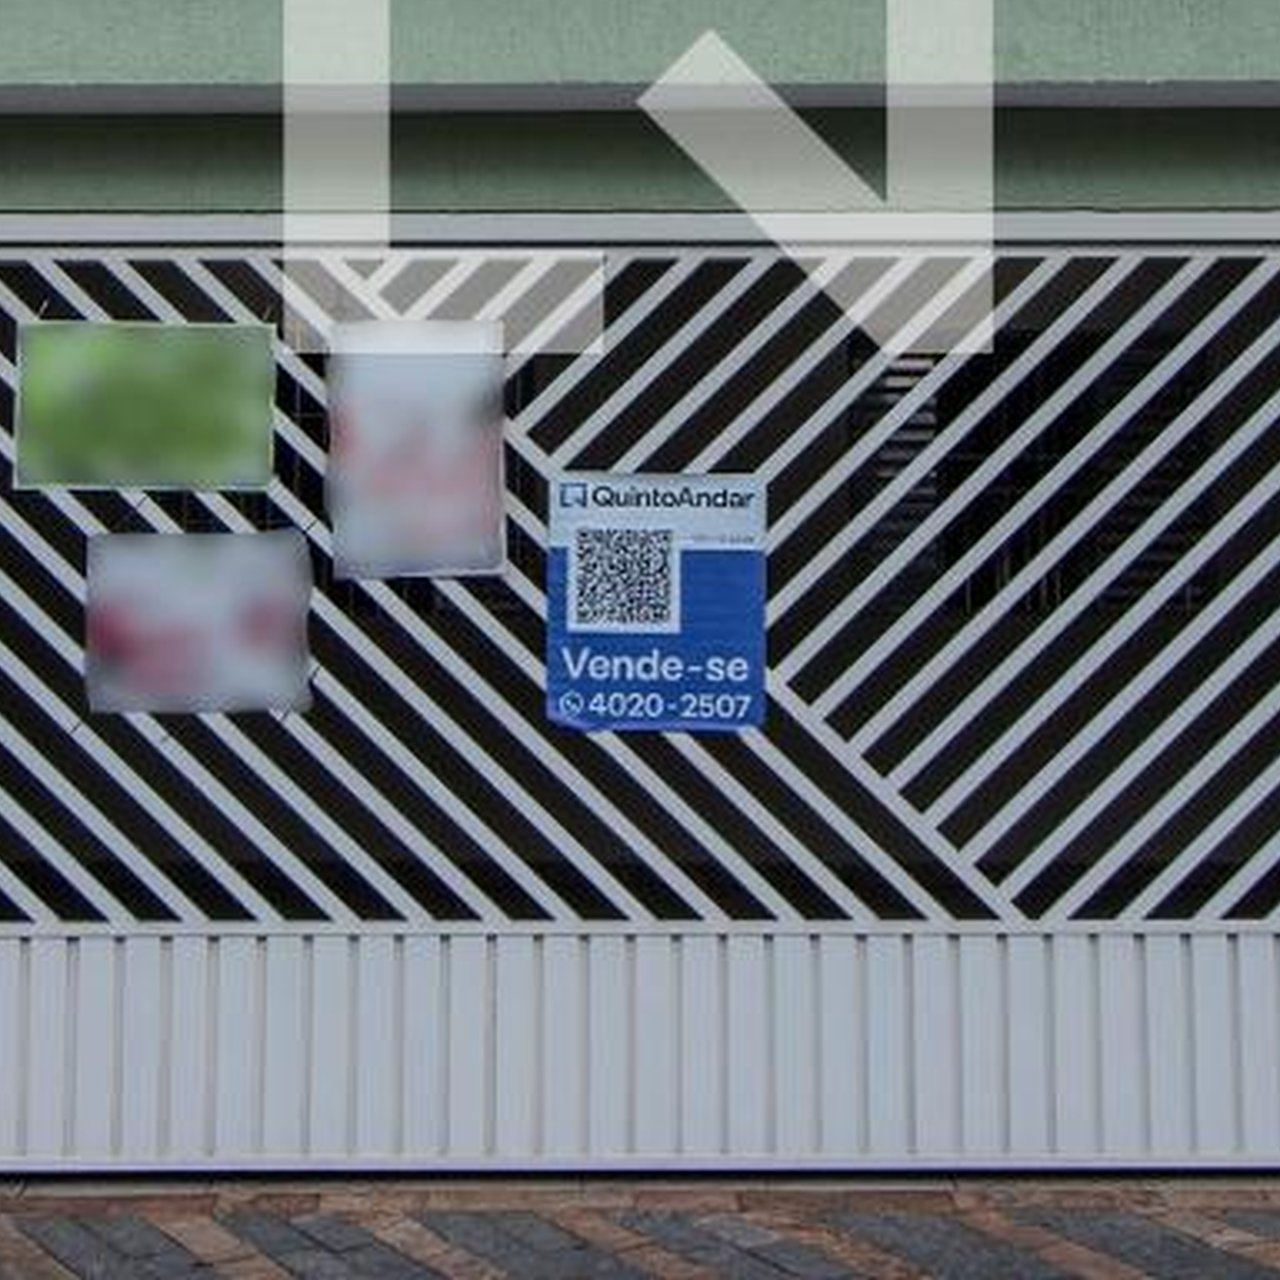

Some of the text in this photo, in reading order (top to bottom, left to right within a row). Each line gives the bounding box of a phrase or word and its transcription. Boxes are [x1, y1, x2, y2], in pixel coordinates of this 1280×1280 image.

[592, 485, 755, 508] QuintoAndar
[561, 647, 749, 681] Vende-se
[588, 692, 752, 718] 4020-2507
